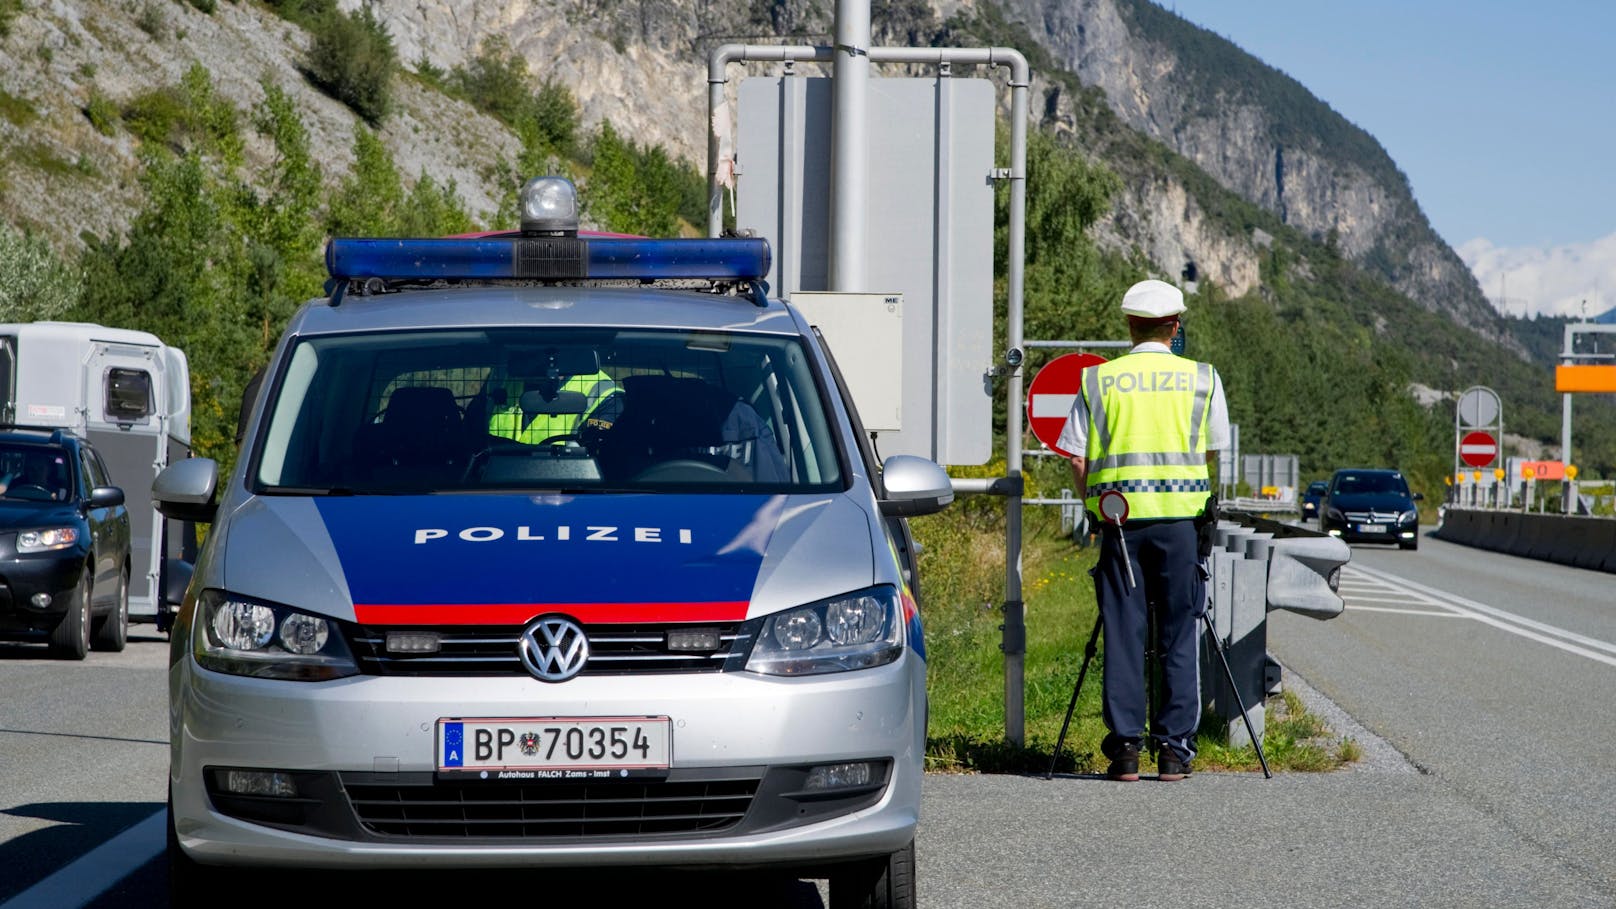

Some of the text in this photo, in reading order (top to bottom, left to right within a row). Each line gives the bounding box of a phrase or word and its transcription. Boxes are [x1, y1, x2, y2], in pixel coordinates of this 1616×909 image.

[1101, 371, 1194, 396] POLIZEI
[414, 526, 692, 544] POLIZEI
[475, 727, 650, 761] BP 70354
[449, 750, 459, 761] A
[498, 770, 535, 779] Autohaus
[538, 770, 562, 778] FALCH
[593, 769, 611, 777] Imst
